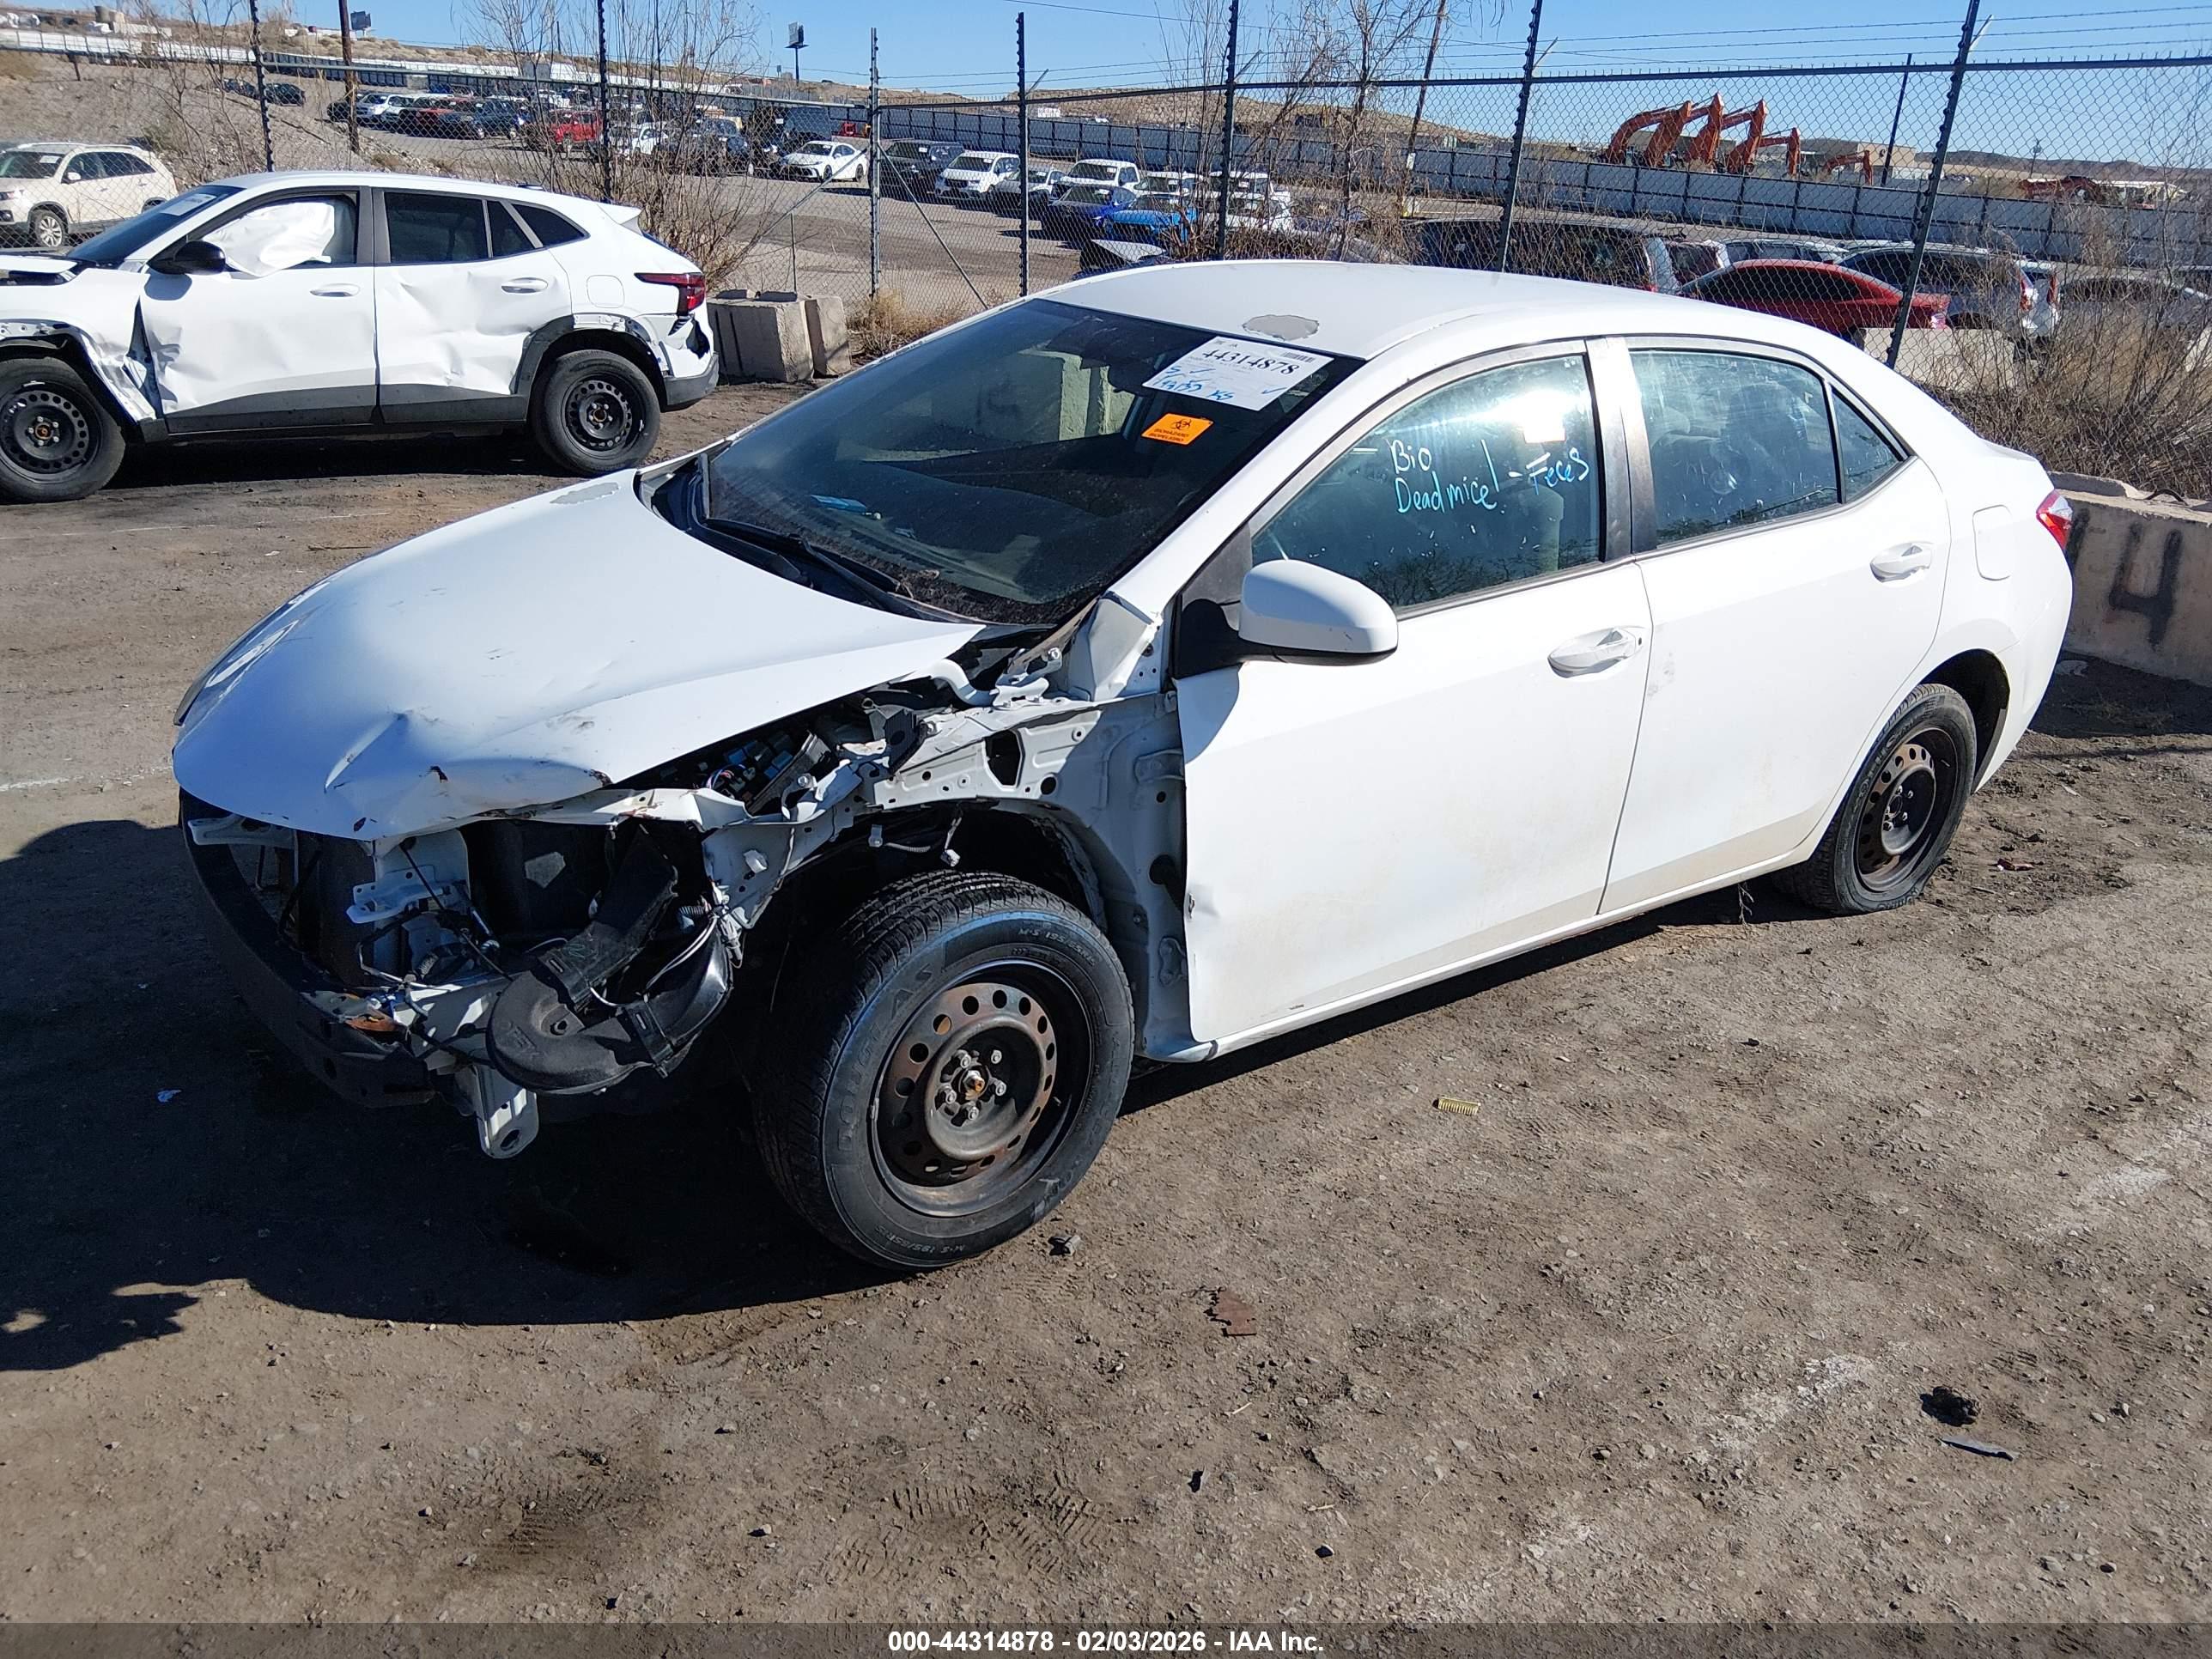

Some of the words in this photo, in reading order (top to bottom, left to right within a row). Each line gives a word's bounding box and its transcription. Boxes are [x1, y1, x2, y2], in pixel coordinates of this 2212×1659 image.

[1201, 349, 1300, 375] 44314878
[1385, 438, 1433, 475] Bio
[1393, 471, 1446, 514] Dead
